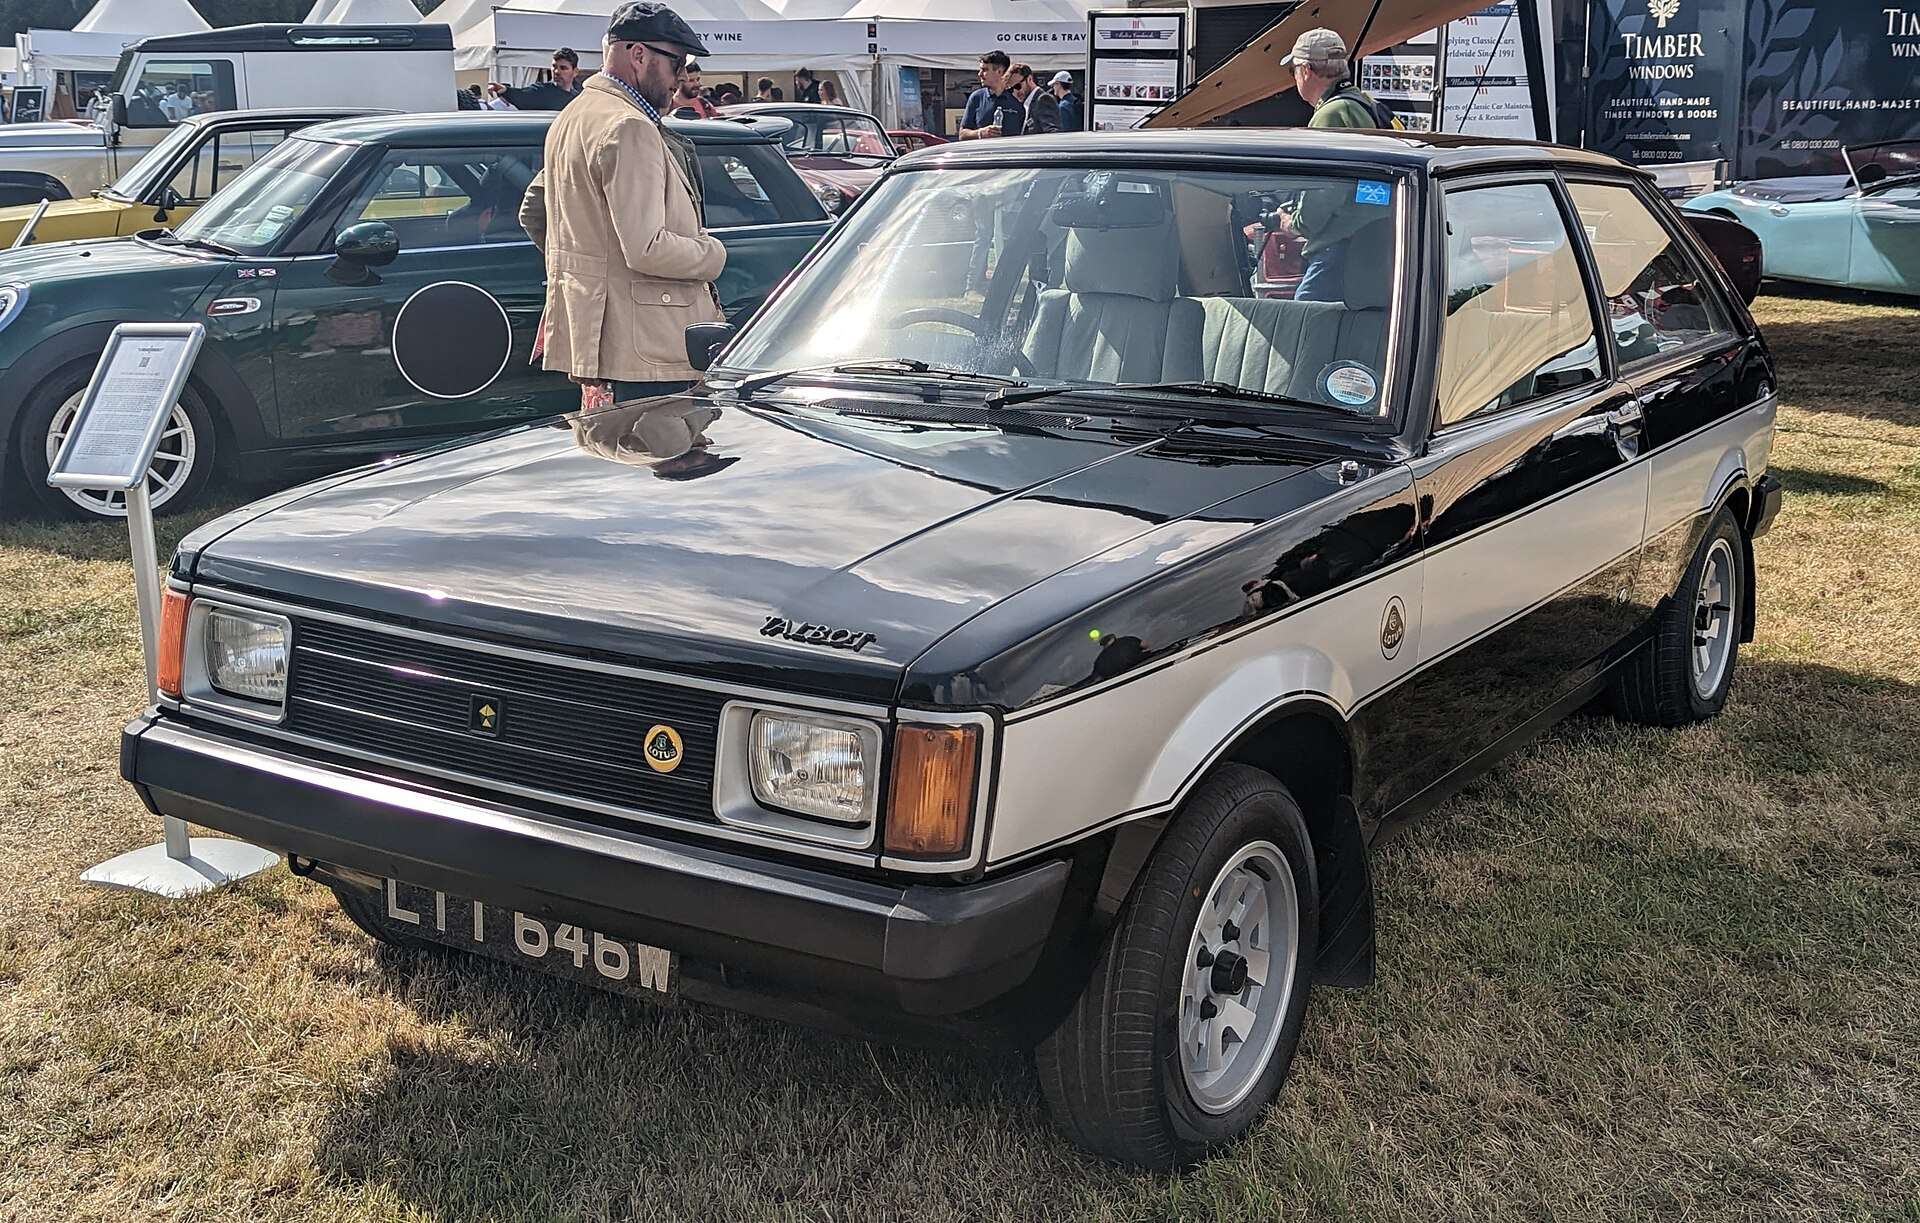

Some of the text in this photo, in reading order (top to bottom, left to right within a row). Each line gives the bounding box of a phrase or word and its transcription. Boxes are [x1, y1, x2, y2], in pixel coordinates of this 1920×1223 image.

[713, 33, 743, 41] WINE
[996, 33, 1087, 41] GO CRUISE & TRAV
[1471, 36, 1496, 44] Classic
[1621, 33, 1705, 59] TIMBER
[1498, 49, 1515, 57] 1991
[1628, 64, 1694, 80] WINDOWS
[1611, 97, 1711, 107] BEAUTIFUL, HAND-MADE
[1604, 110, 1718, 119] TIMBER WINDOWS & DOORS
[648, 745, 677, 759] LOTUS
